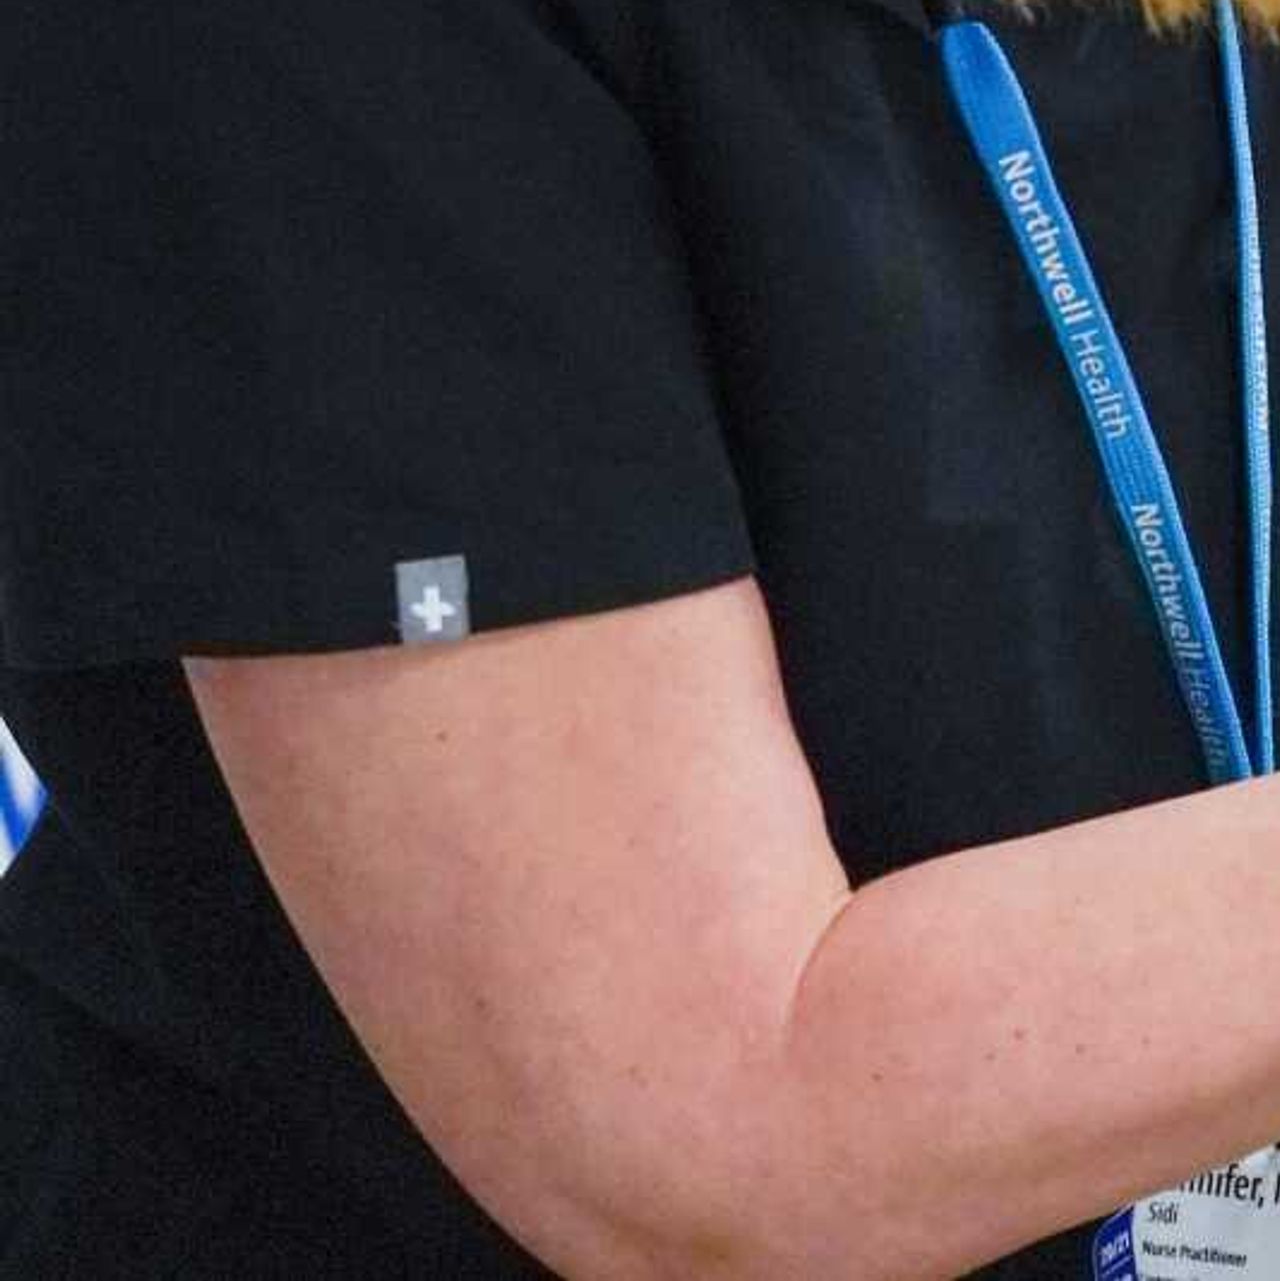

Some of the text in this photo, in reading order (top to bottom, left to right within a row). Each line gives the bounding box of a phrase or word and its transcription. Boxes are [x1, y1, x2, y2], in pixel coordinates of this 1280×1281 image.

[998, 149, 1133, 440] Northwell Health
[1131, 503, 1204, 661] Northwell
[1149, 1201, 1178, 1225] Sidi
